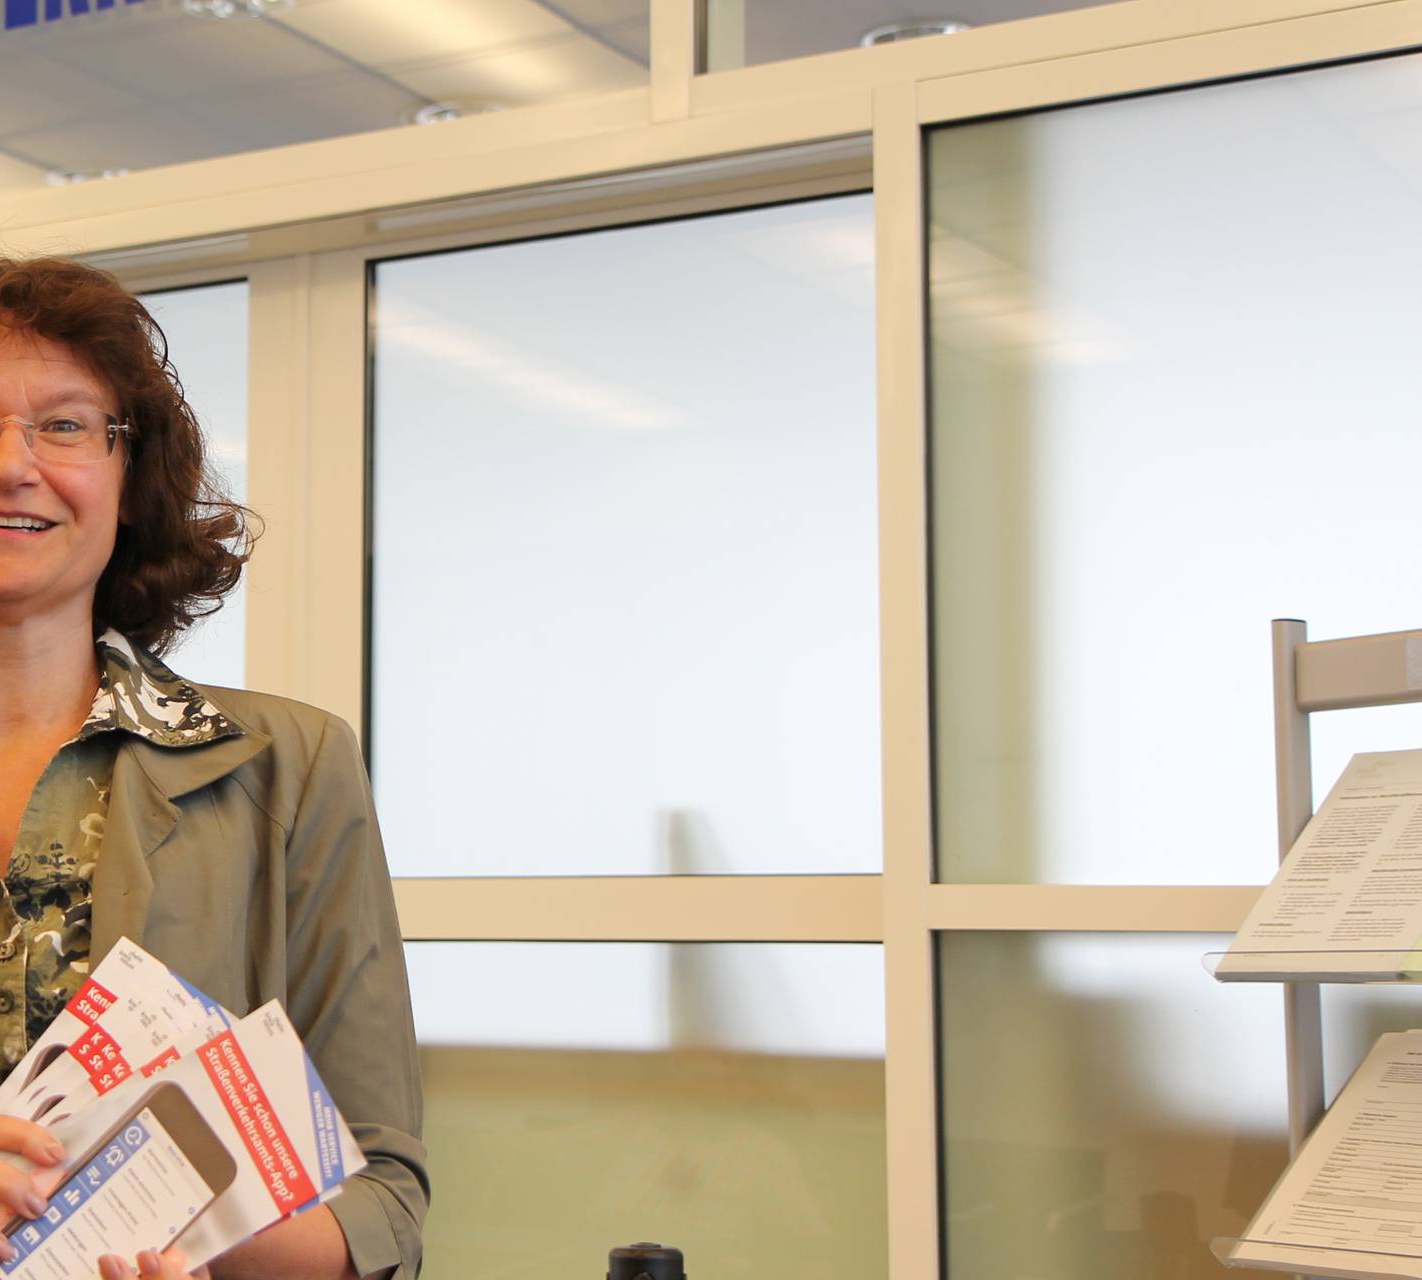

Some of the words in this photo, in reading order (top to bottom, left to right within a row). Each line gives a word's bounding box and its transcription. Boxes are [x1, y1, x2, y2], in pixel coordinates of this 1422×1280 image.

[205, 1046, 296, 1202] Straßenverkehrsamts-App?
[219, 1037, 246, 1085] Kennen
[242, 1082, 258, 1103] Sie
[253, 1100, 276, 1134] schon
[271, 1132, 298, 1181] unsere
